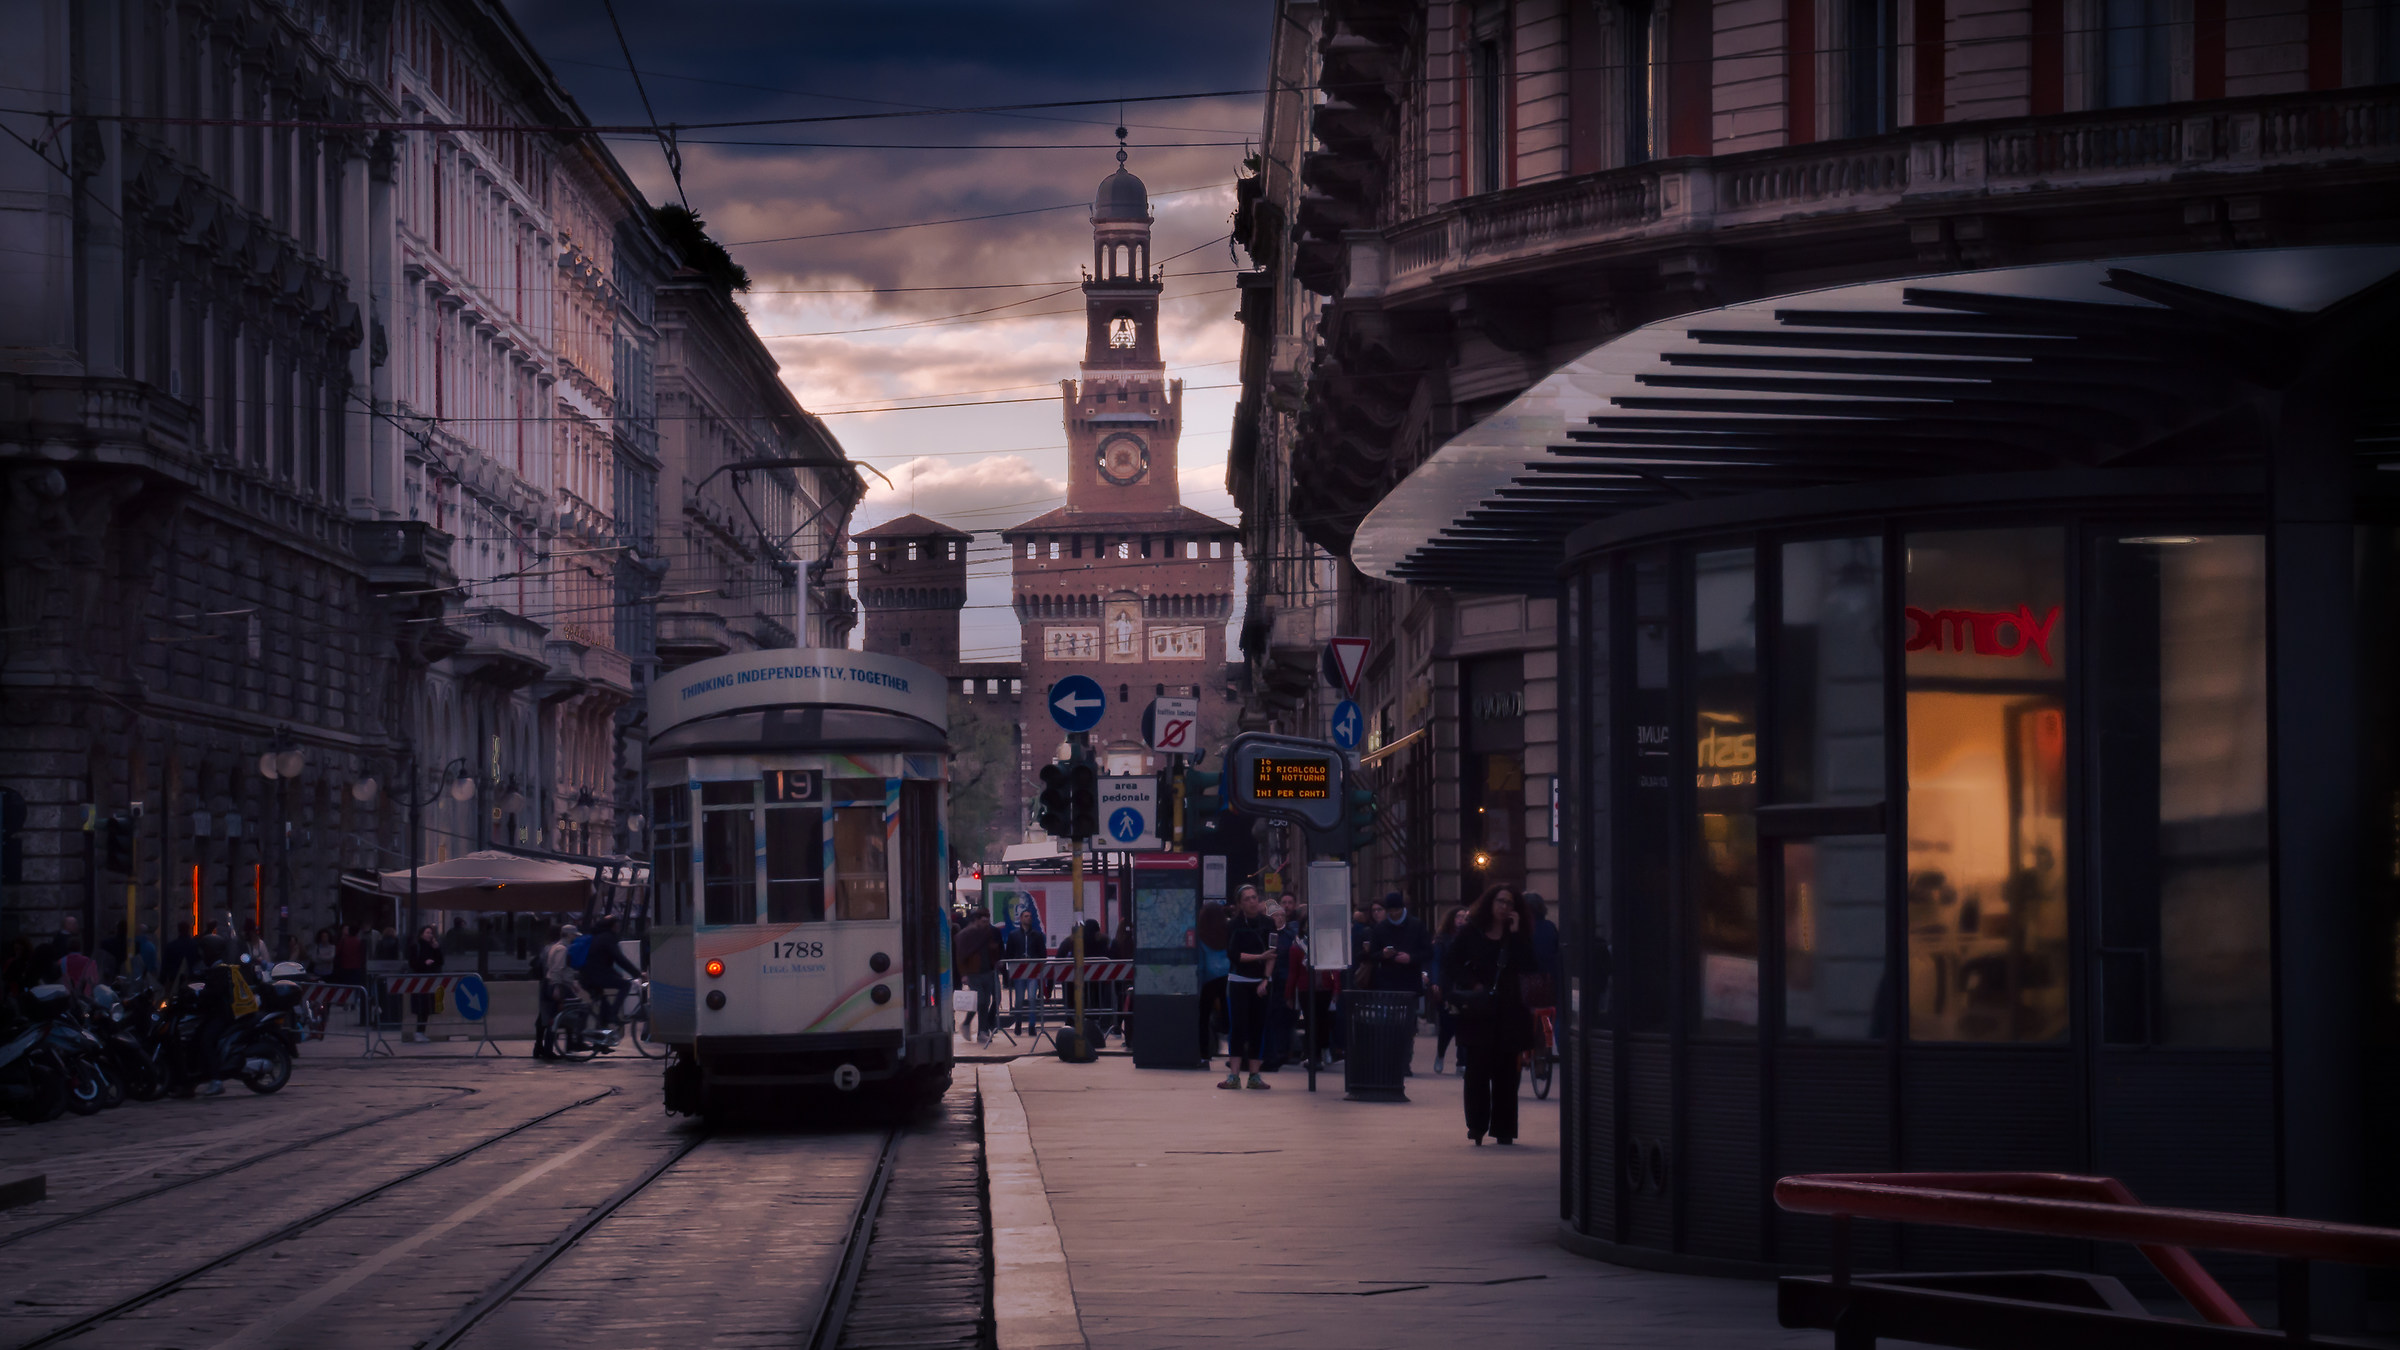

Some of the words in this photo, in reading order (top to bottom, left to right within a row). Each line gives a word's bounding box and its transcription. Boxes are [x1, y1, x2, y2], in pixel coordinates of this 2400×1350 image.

[681, 674, 734, 701] THINKING
[737, 666, 846, 685] INDEPENDENTLY,
[849, 668, 912, 694] TOGETHER.
[1261, 758, 1272, 766] 16
[1276, 766, 1326, 774] RICALCOLO
[1281, 774, 1326, 782] NOTTURNA
[776, 770, 813, 801] 19
[1102, 793, 1150, 803] pedonale
[1256, 789, 1272, 798] INI
[1277, 789, 1294, 798] PER
[774, 941, 823, 959] 1788
